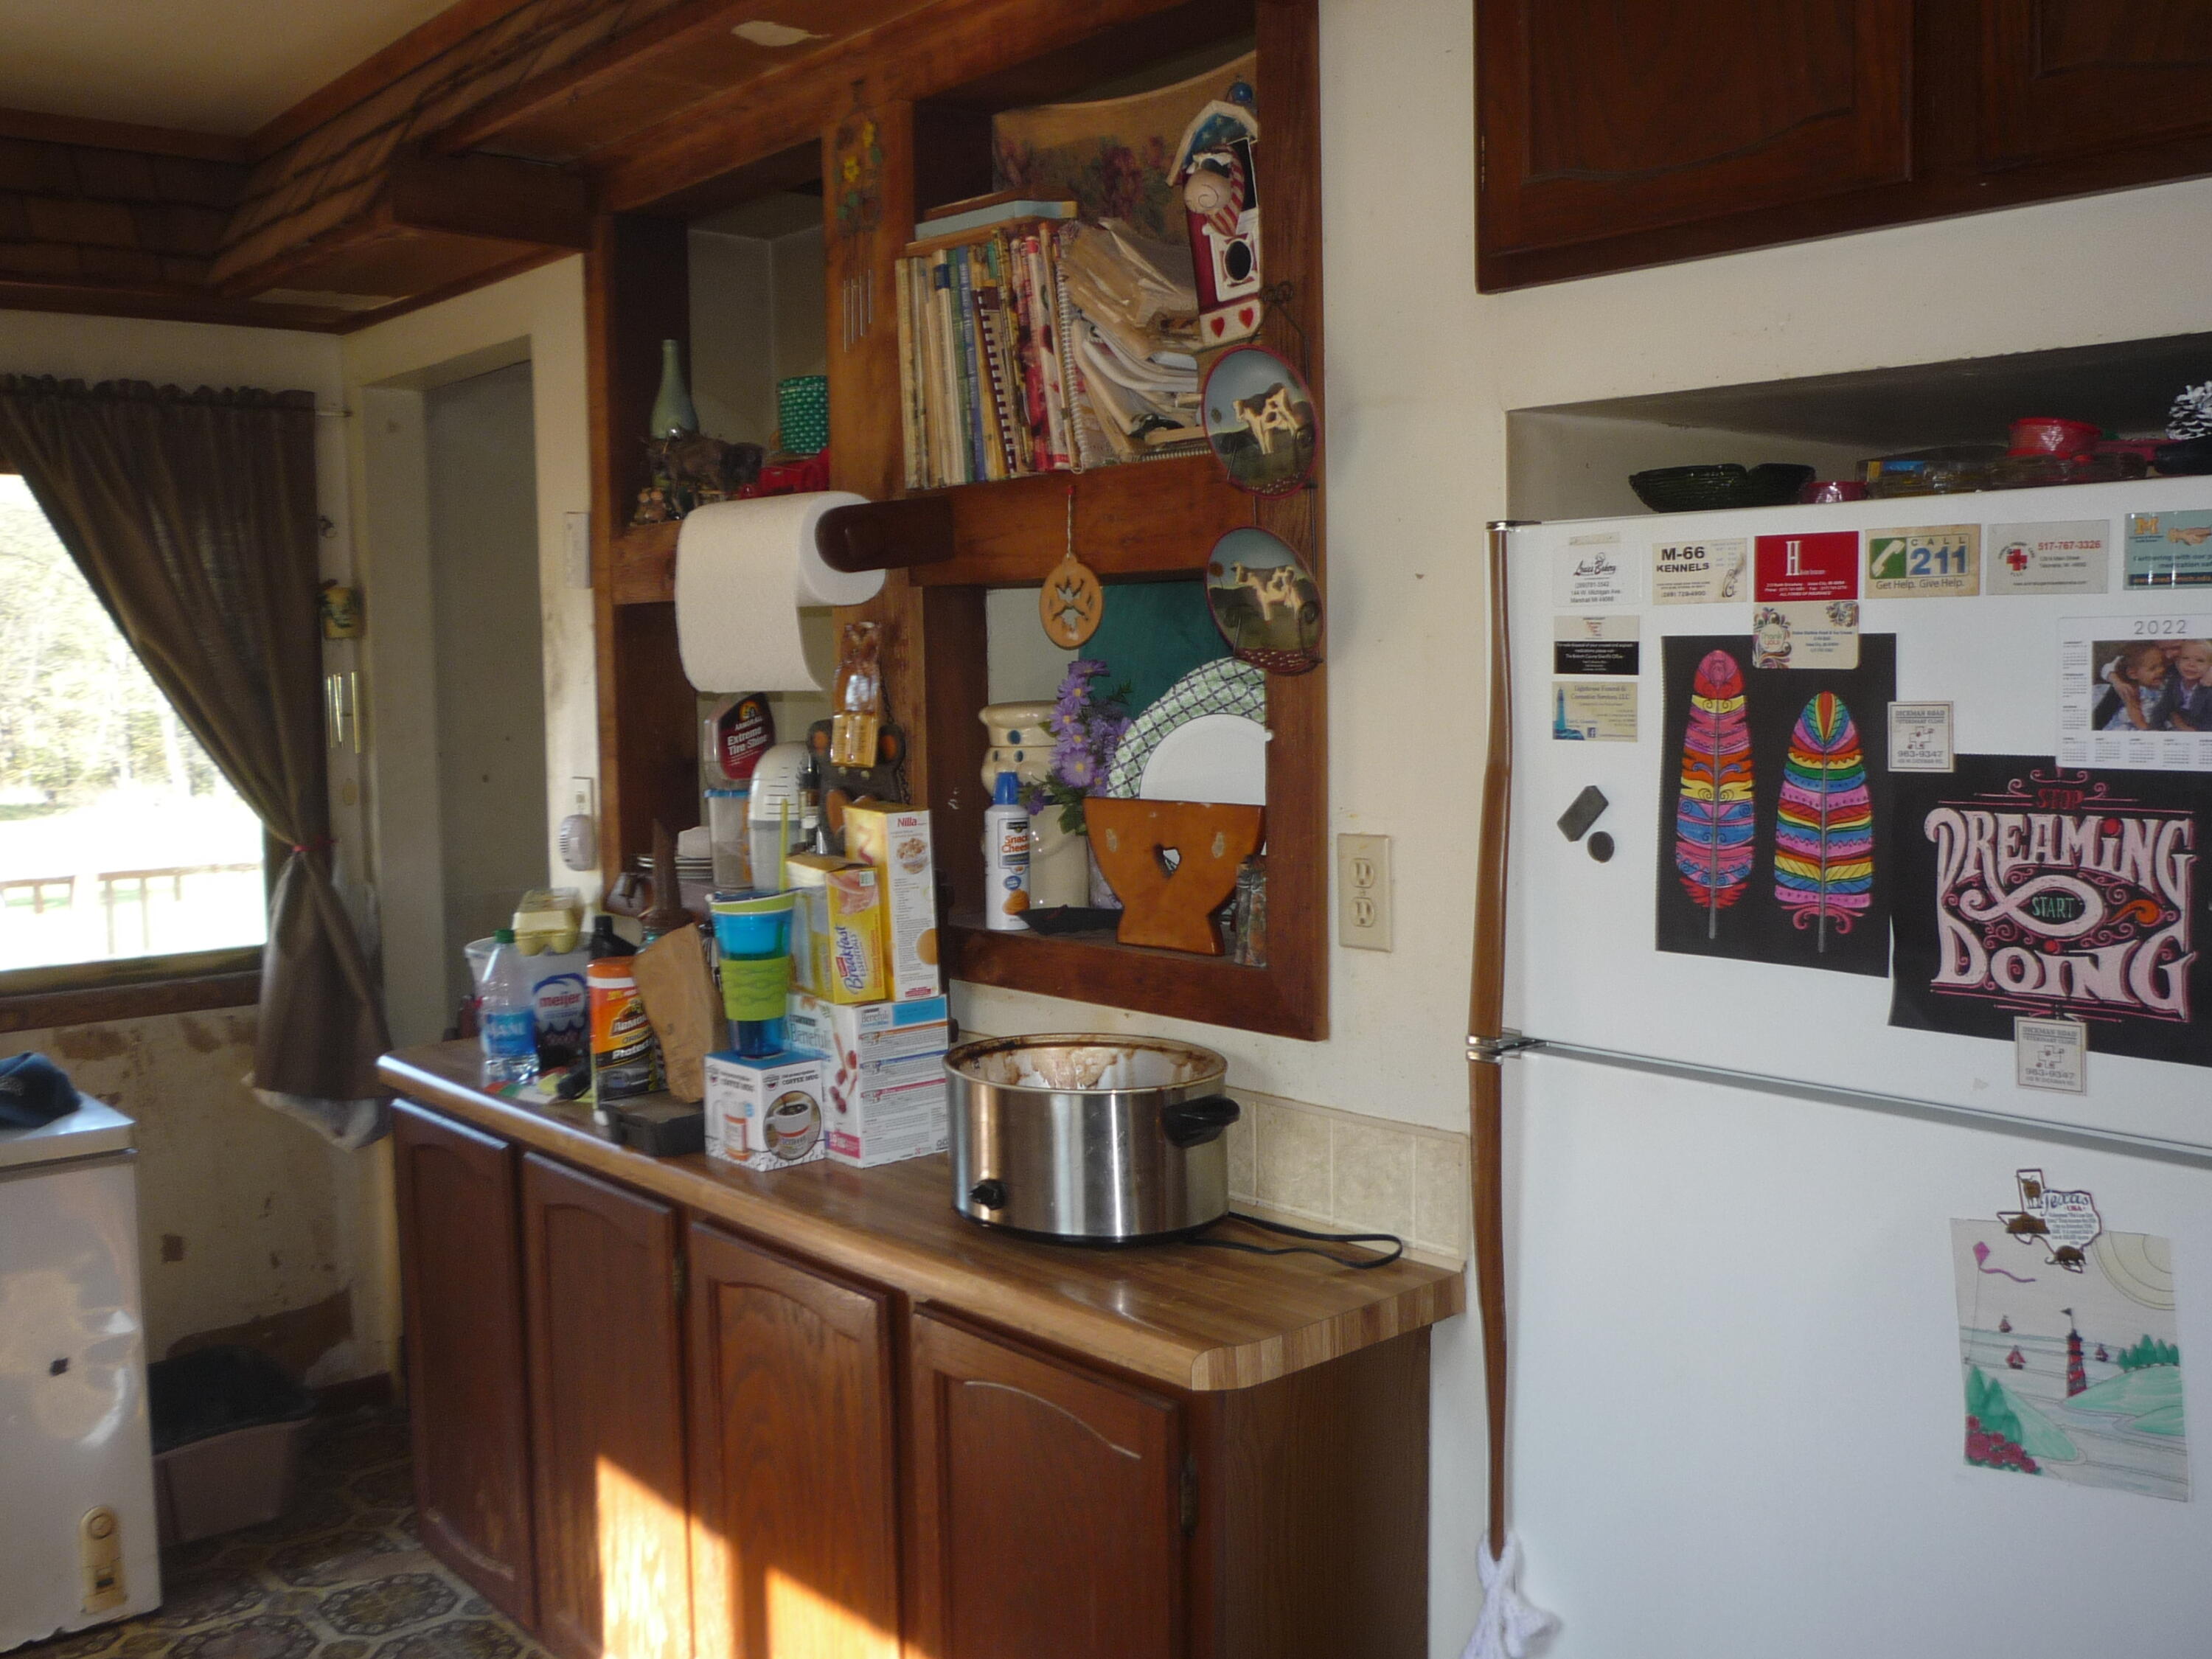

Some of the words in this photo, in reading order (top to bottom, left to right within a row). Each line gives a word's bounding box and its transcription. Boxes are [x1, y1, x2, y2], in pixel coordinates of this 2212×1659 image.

[1910, 536, 1966, 546] CALL
[1661, 546, 1705, 561] M-66
[1910, 544, 1966, 576] 211
[1656, 563, 1710, 572] KENNELS
[1876, 581, 1891, 589] Get
[1893, 580, 1916, 590] Help.
[1919, 579, 1939, 588] Give
[1941, 578, 1964, 588] Help.
[2133, 619, 2188, 636] 2022
[2038, 788, 2084, 810] STOP
[897, 817, 917, 827] Nilla
[2031, 895, 2075, 919] START
[835, 923, 864, 995] Breakfast
[2040, 1193, 2089, 1217] Texas
